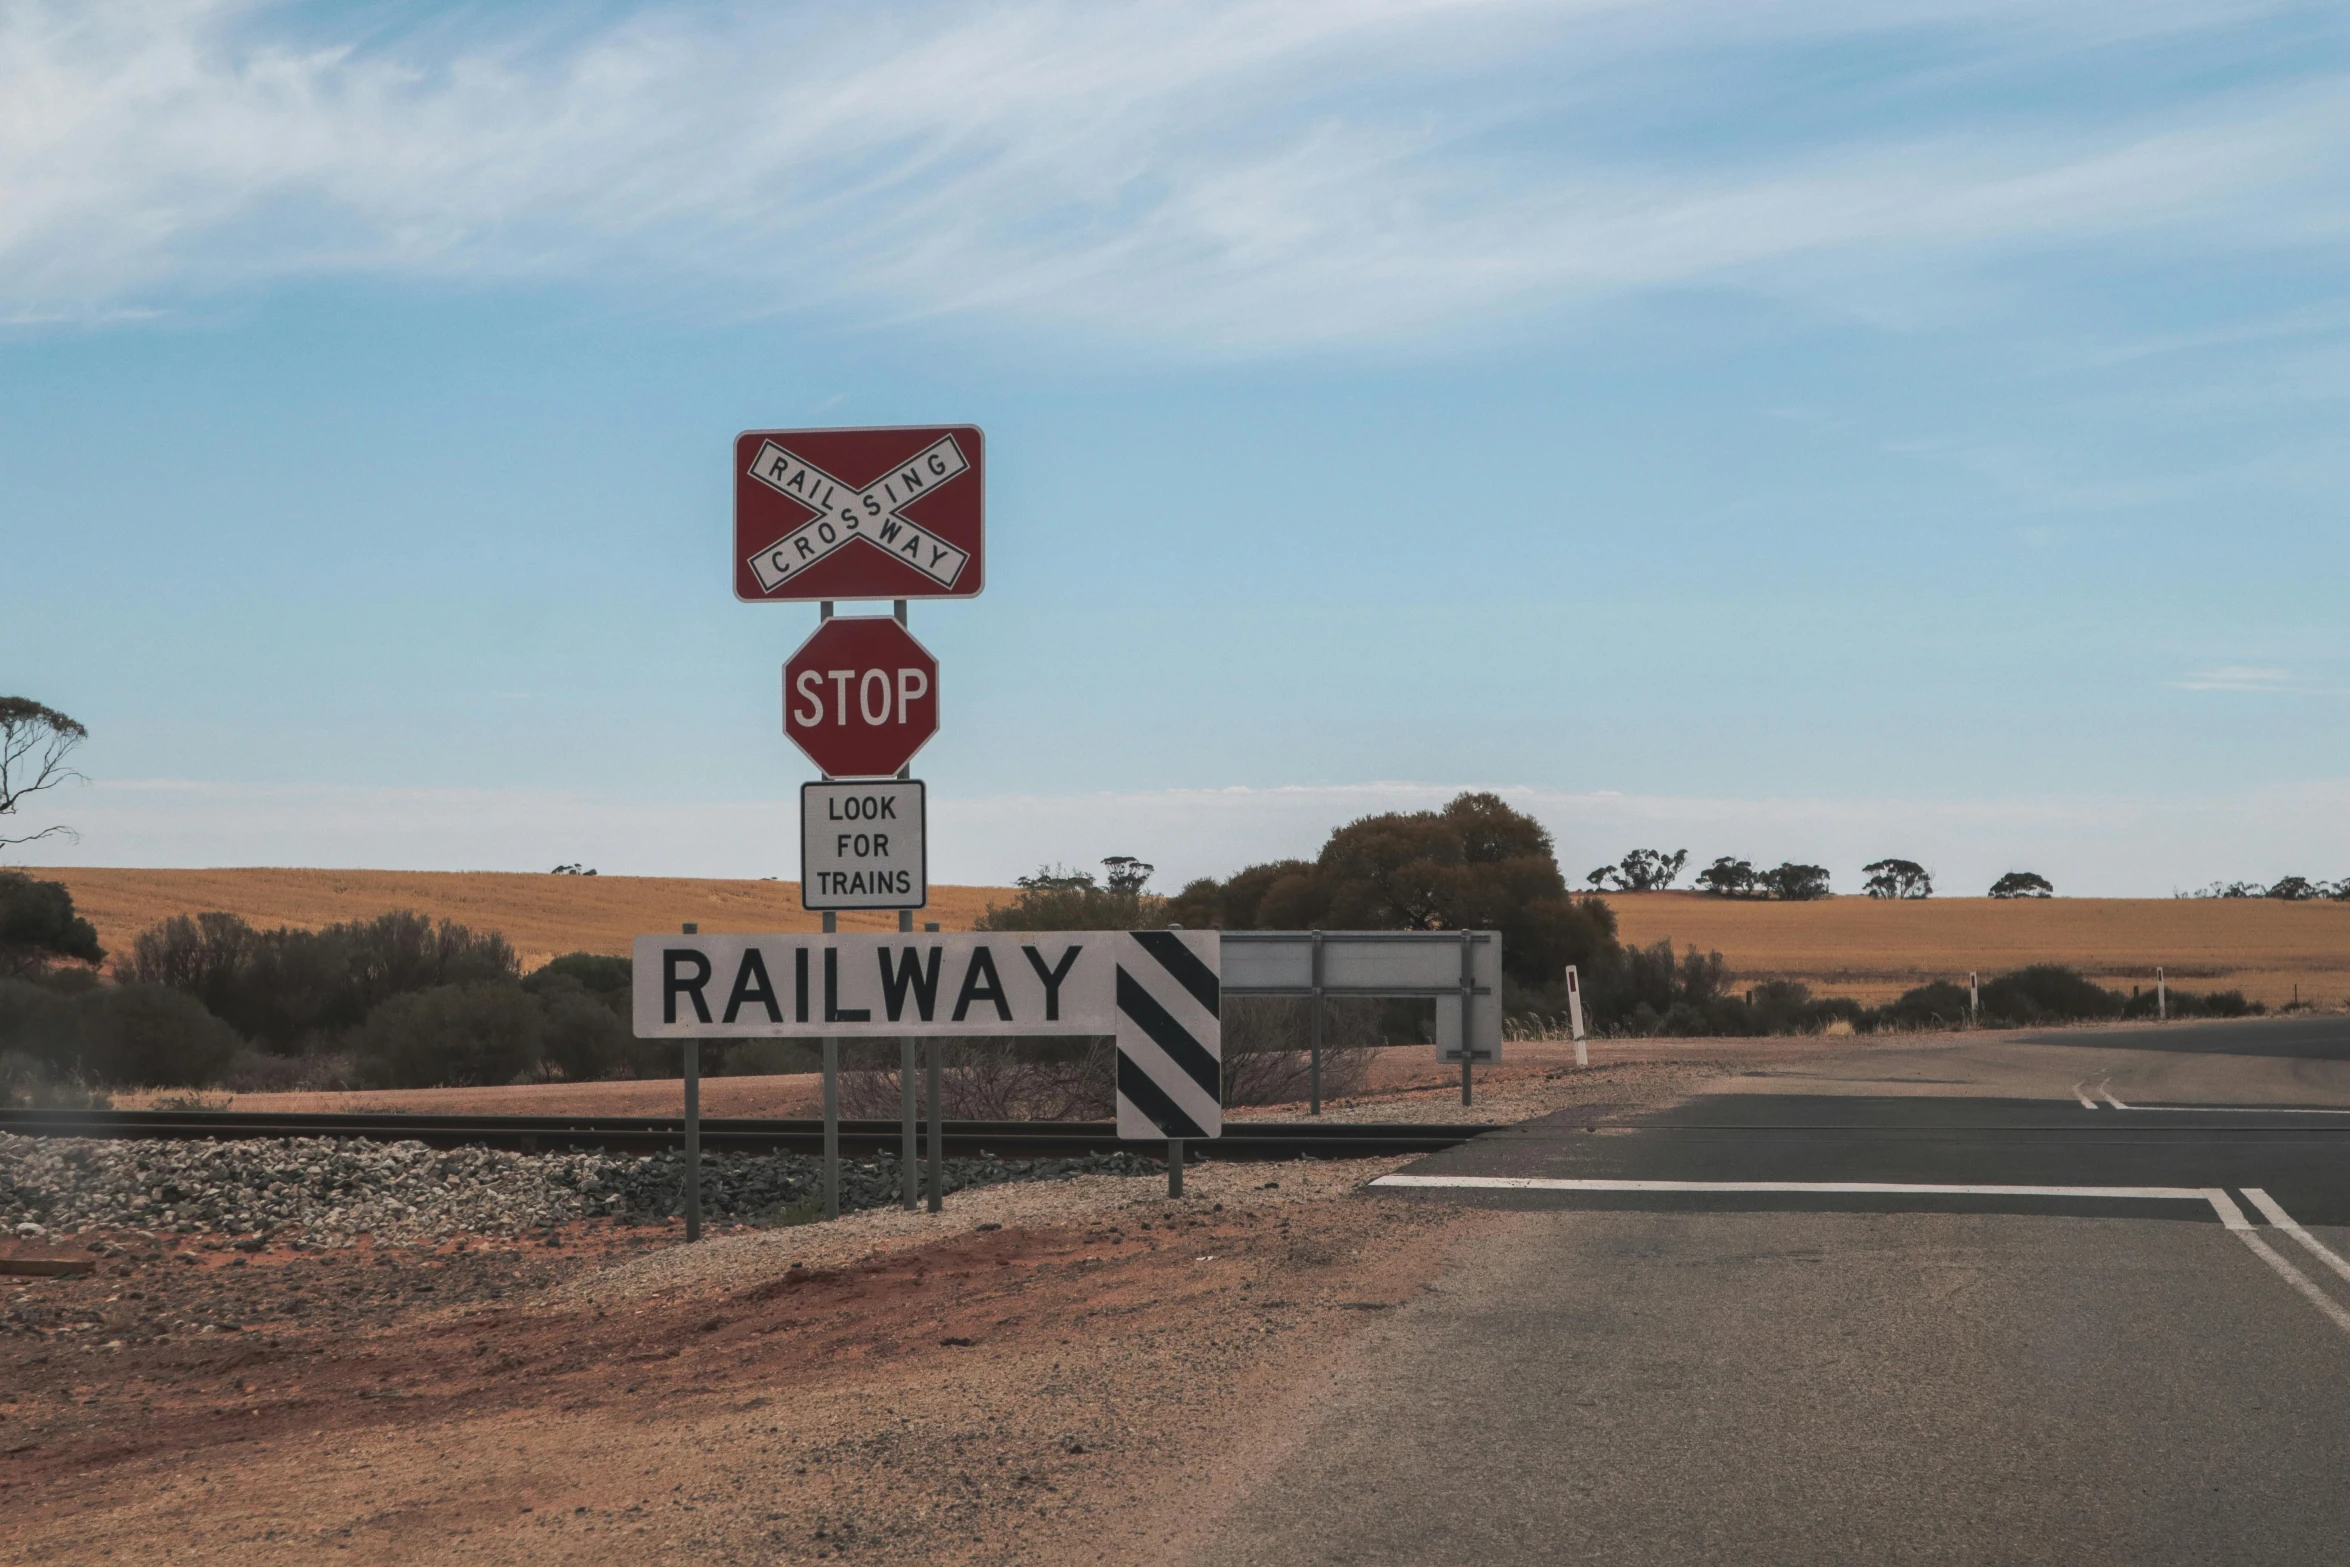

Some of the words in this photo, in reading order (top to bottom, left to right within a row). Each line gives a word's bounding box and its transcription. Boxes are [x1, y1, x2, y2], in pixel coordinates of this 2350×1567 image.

[771, 454, 946, 573] CROSSING
[793, 668, 928, 728] STOP
[829, 796, 897, 821] LOOK
[837, 834, 889, 857] FOR
[817, 870, 911, 895] TRAINS
[662, 945, 1084, 1024] RAILWAY
